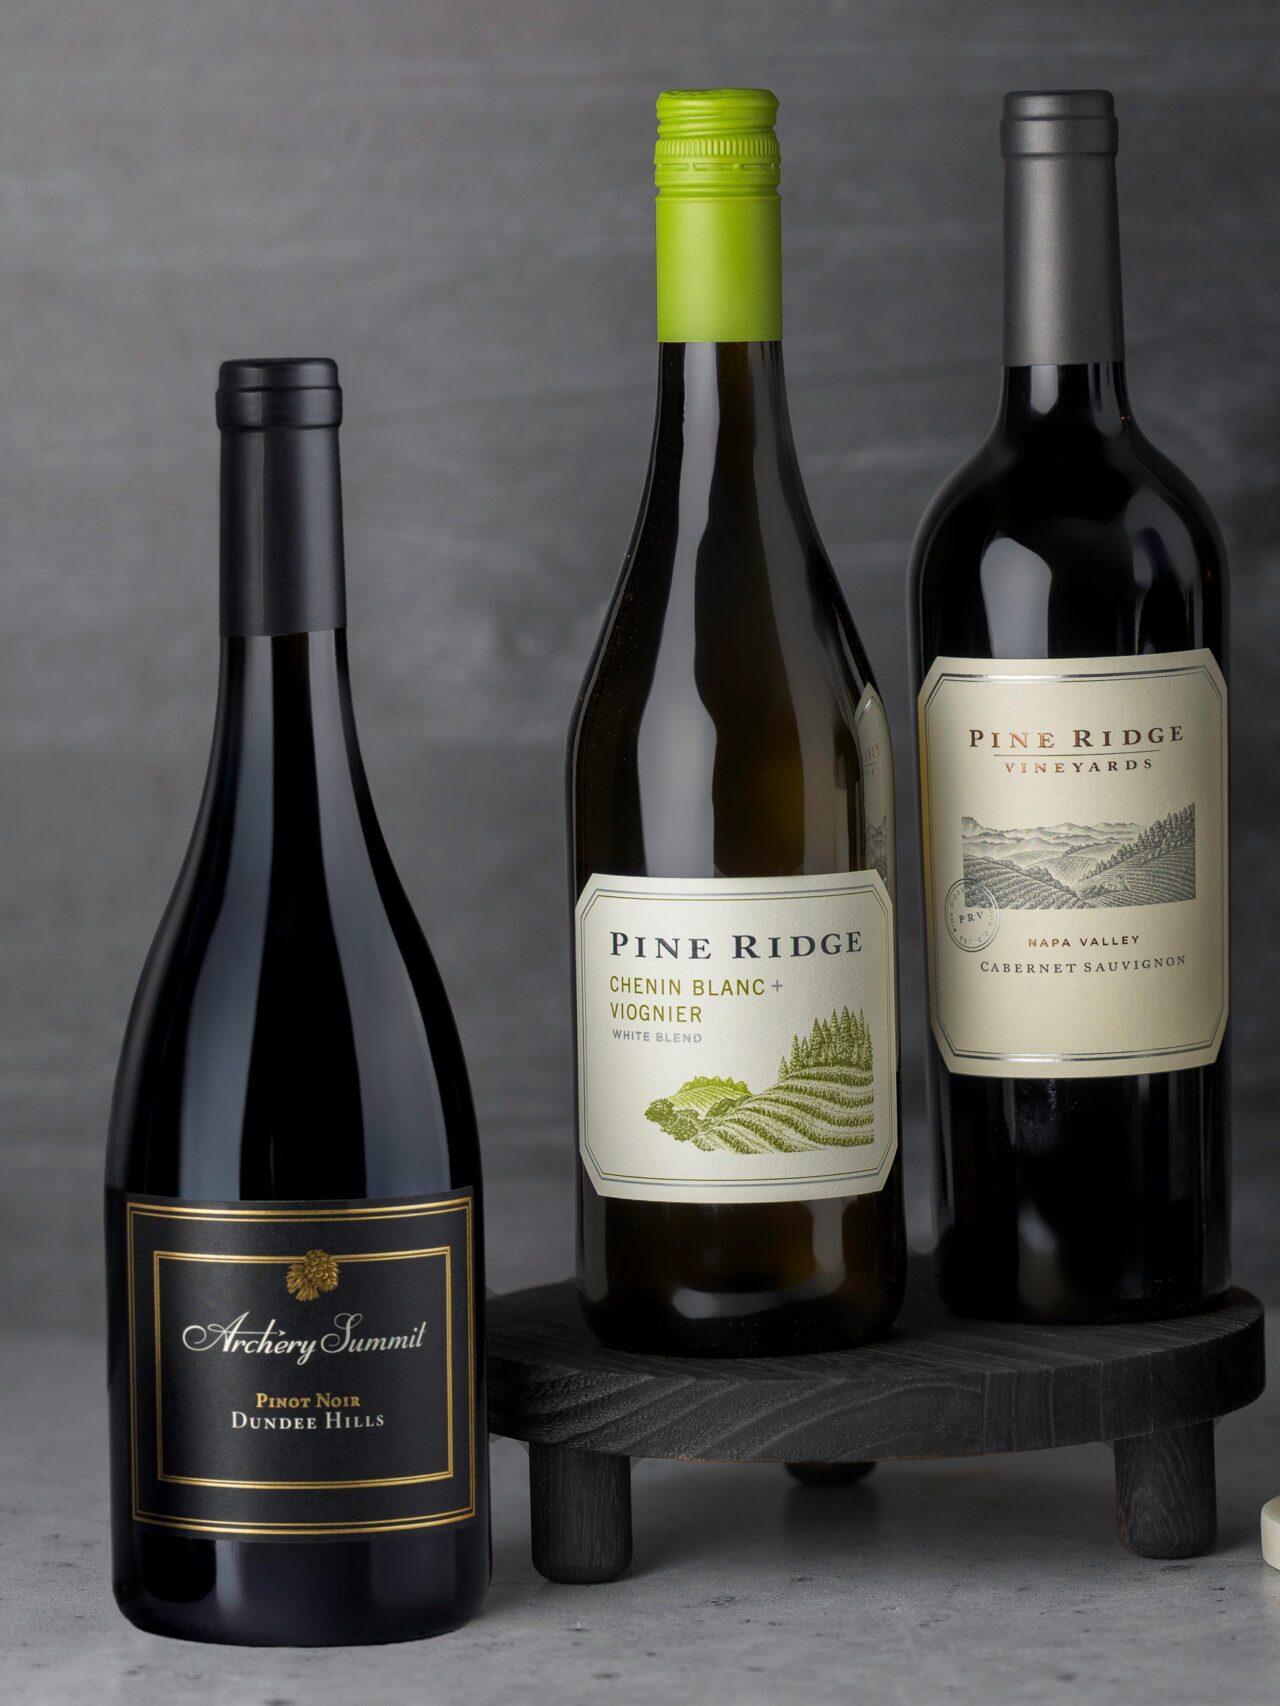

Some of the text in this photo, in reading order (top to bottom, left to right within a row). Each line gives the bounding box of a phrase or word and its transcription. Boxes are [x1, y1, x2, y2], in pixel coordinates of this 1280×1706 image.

[969, 725, 1184, 749] PINE RIDGE
[1005, 758, 1153, 774] VINEYARDS
[610, 931, 863, 960] PINE RIDGE
[1028, 935, 1140, 948] NAPA VALLEY
[980, 954, 1186, 974] CABERNET SAUVIGNON
[609, 975, 681, 996] CHENIN
[692, 978, 765, 996] BLANC
[609, 1001, 703, 1024] VIOGNIER
[612, 1029, 703, 1044] WHITE BLEND
[182, 1311, 427, 1365] Archery Summit
[256, 1392, 361, 1408] PINOT NOIR
[231, 1411, 384, 1430] DUNDEE HILLS
